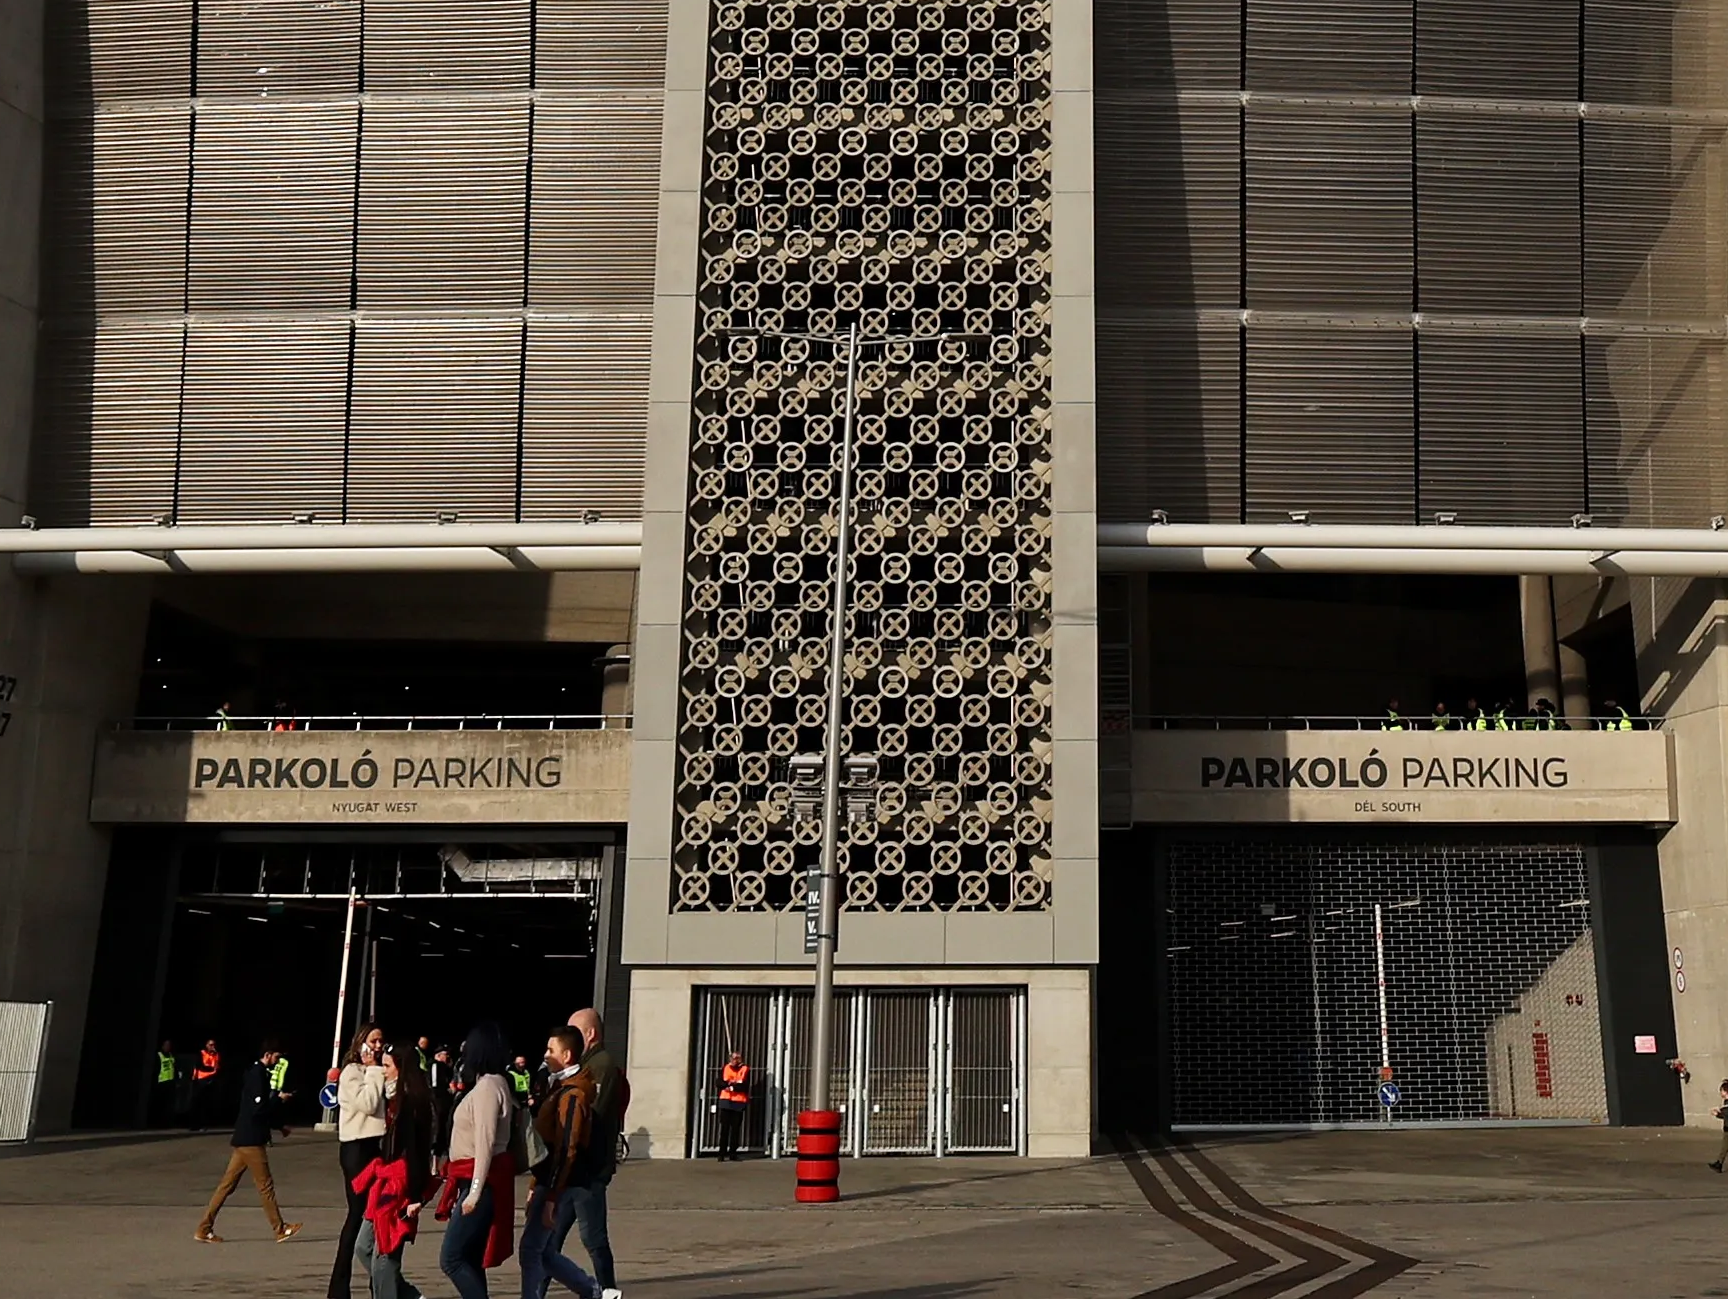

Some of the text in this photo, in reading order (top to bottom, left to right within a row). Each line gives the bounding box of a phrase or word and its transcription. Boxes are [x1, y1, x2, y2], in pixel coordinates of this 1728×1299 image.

[194, 748, 562, 789] PARKOLÓ PARKING
[1201, 748, 1568, 788] PARKOLÓ PARKING
[332, 802, 417, 813] NYUGAT WEST
[1355, 800, 1421, 812] DÉL SOUTH
